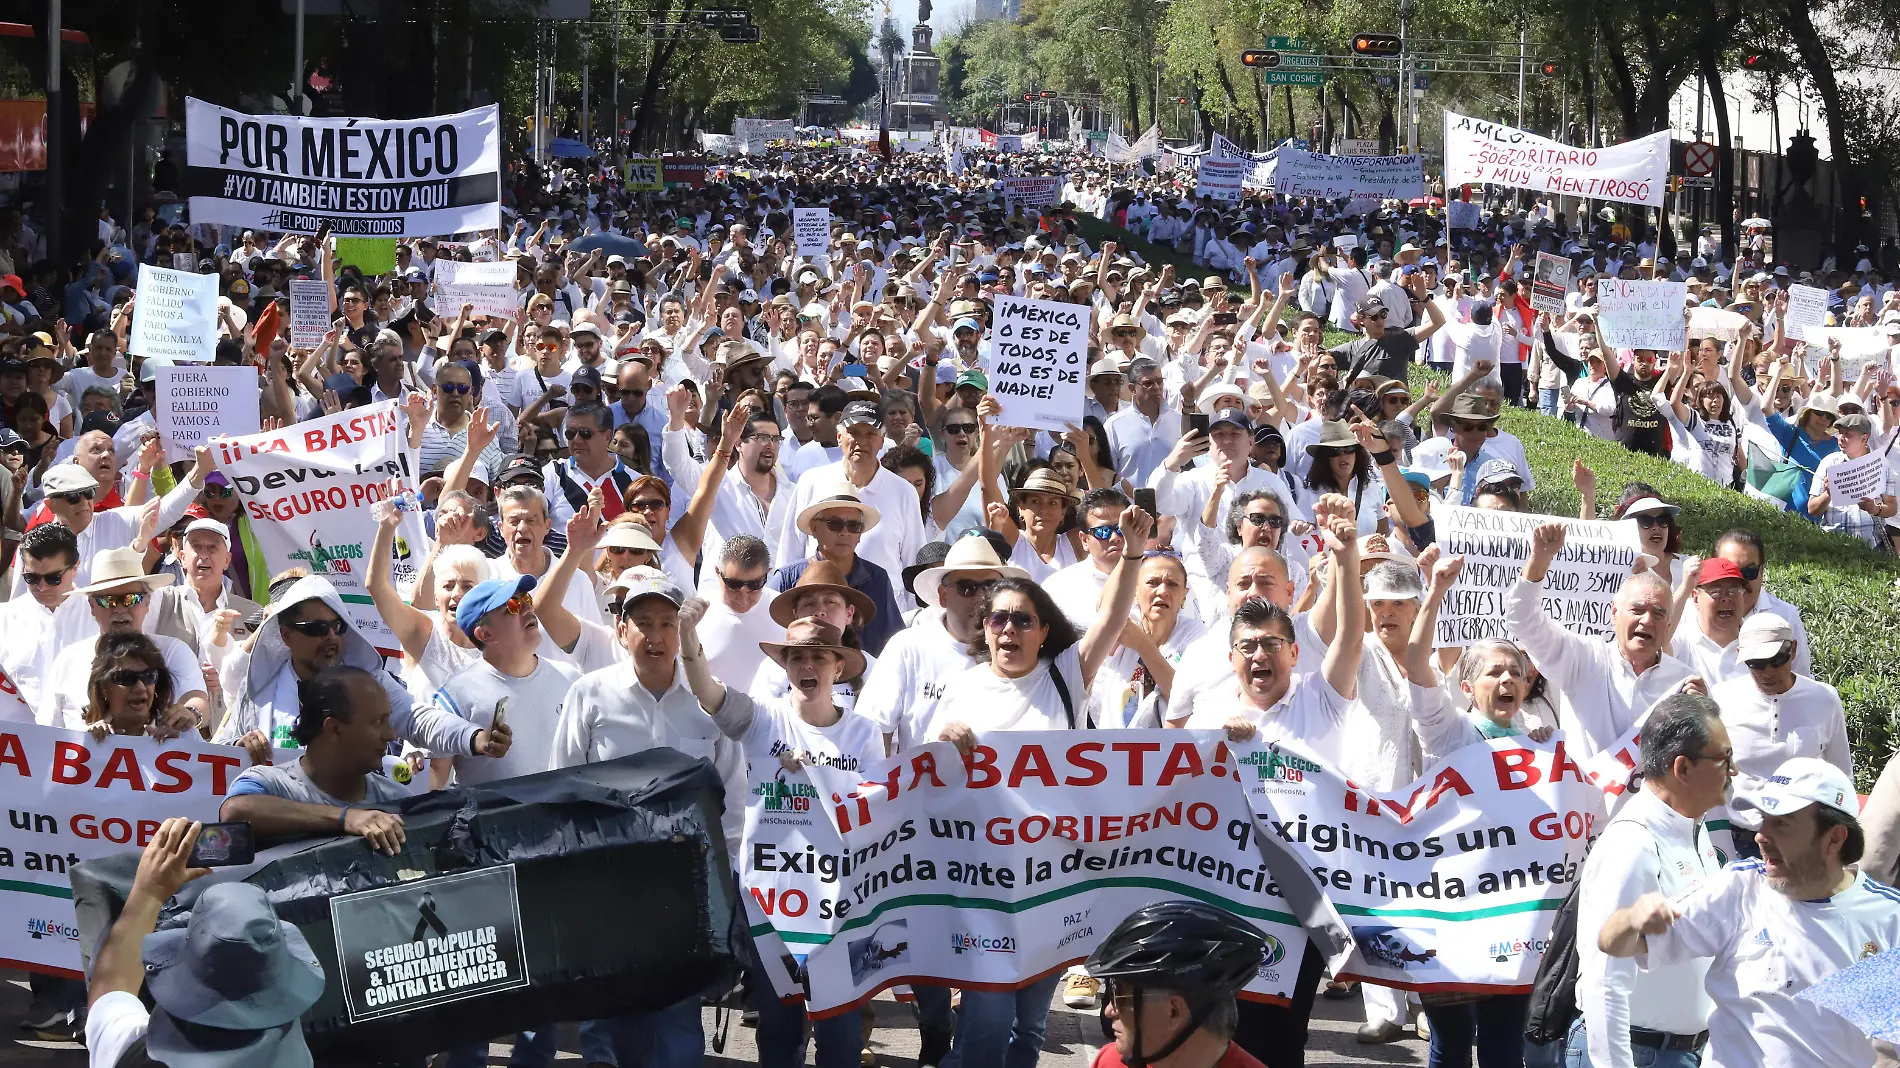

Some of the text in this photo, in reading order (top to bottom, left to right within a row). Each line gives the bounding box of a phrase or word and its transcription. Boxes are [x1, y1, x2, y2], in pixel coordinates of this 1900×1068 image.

[1270, 74, 1317, 83] SAN COSME
[219, 115, 458, 180] POR MÉXICO
[677, 163, 704, 171] morales
[1329, 155, 1417, 167] TRANSFORMACION
[1401, 174, 1410, 184] de
[1546, 175, 1649, 201] MENTIROSO
[223, 174, 449, 212] #YO TAMBIÉN ESTOY AQUÍ
[1291, 183, 1321, 197] Fuera
[1326, 186, 1342, 198] Por
[1349, 189, 1384, 199] Incapaz
[262, 209, 402, 234] #ELPODESOMOSTODOS
[146, 295, 184, 309] FALLIDO
[1532, 302, 1561, 314] CORRUPTO
[1533, 294, 1563, 307] MENTIROSO
[144, 307, 184, 320] VAMOS A
[1000, 301, 1081, 331] ¡MÉXICO,
[143, 319, 167, 331] PARO
[1000, 323, 1071, 345] O ES DE
[142, 331, 203, 345] NACIONAL YA
[146, 346, 196, 356] RENUNCIA AMLO
[998, 342, 1079, 366] TODOS, O
[170, 373, 208, 383] FUERA
[996, 361, 1080, 384] NO ES DE
[171, 387, 229, 397] GOBIERNO
[995, 380, 1055, 400] NADIE!
[171, 401, 218, 411] FALLIDO
[171, 416, 220, 426] VAMOS A
[1704, 423, 1733, 431] STAR
[172, 430, 201, 440] PARO
[247, 486, 347, 523] SEGURO
[1440, 590, 1494, 616] MUERTES
[51, 740, 241, 796] BAST
[961, 742, 1242, 789] BASTA!
[1251, 787, 1307, 797] @NSChalecosMx
[8, 808, 59, 835] un
[758, 817, 813, 826] @NSChalecosMx
[753, 818, 916, 884] Exigimos
[928, 817, 976, 843] un
[985, 801, 1219, 846] GOBIERNO
[1256, 813, 1445, 861] xigimos
[1456, 825, 1517, 853] un
[24, 848, 80, 875] ant
[750, 845, 1285, 920] NO se rinda ante la delincuencia
[1318, 865, 1352, 890] se
[1363, 871, 1466, 900] rinda
[1477, 860, 1566, 894] ante
[28, 917, 80, 939] #México
[1063, 908, 1091, 927] PAZ Y
[364, 925, 498, 970] SEGURO POPULAR
[951, 933, 1017, 953] #México21
[1056, 926, 1094, 950] JUSTICIA
[369, 943, 498, 987] & TRATAMIENTOS
[365, 959, 508, 1008] CONTRA EL CÁNCER
